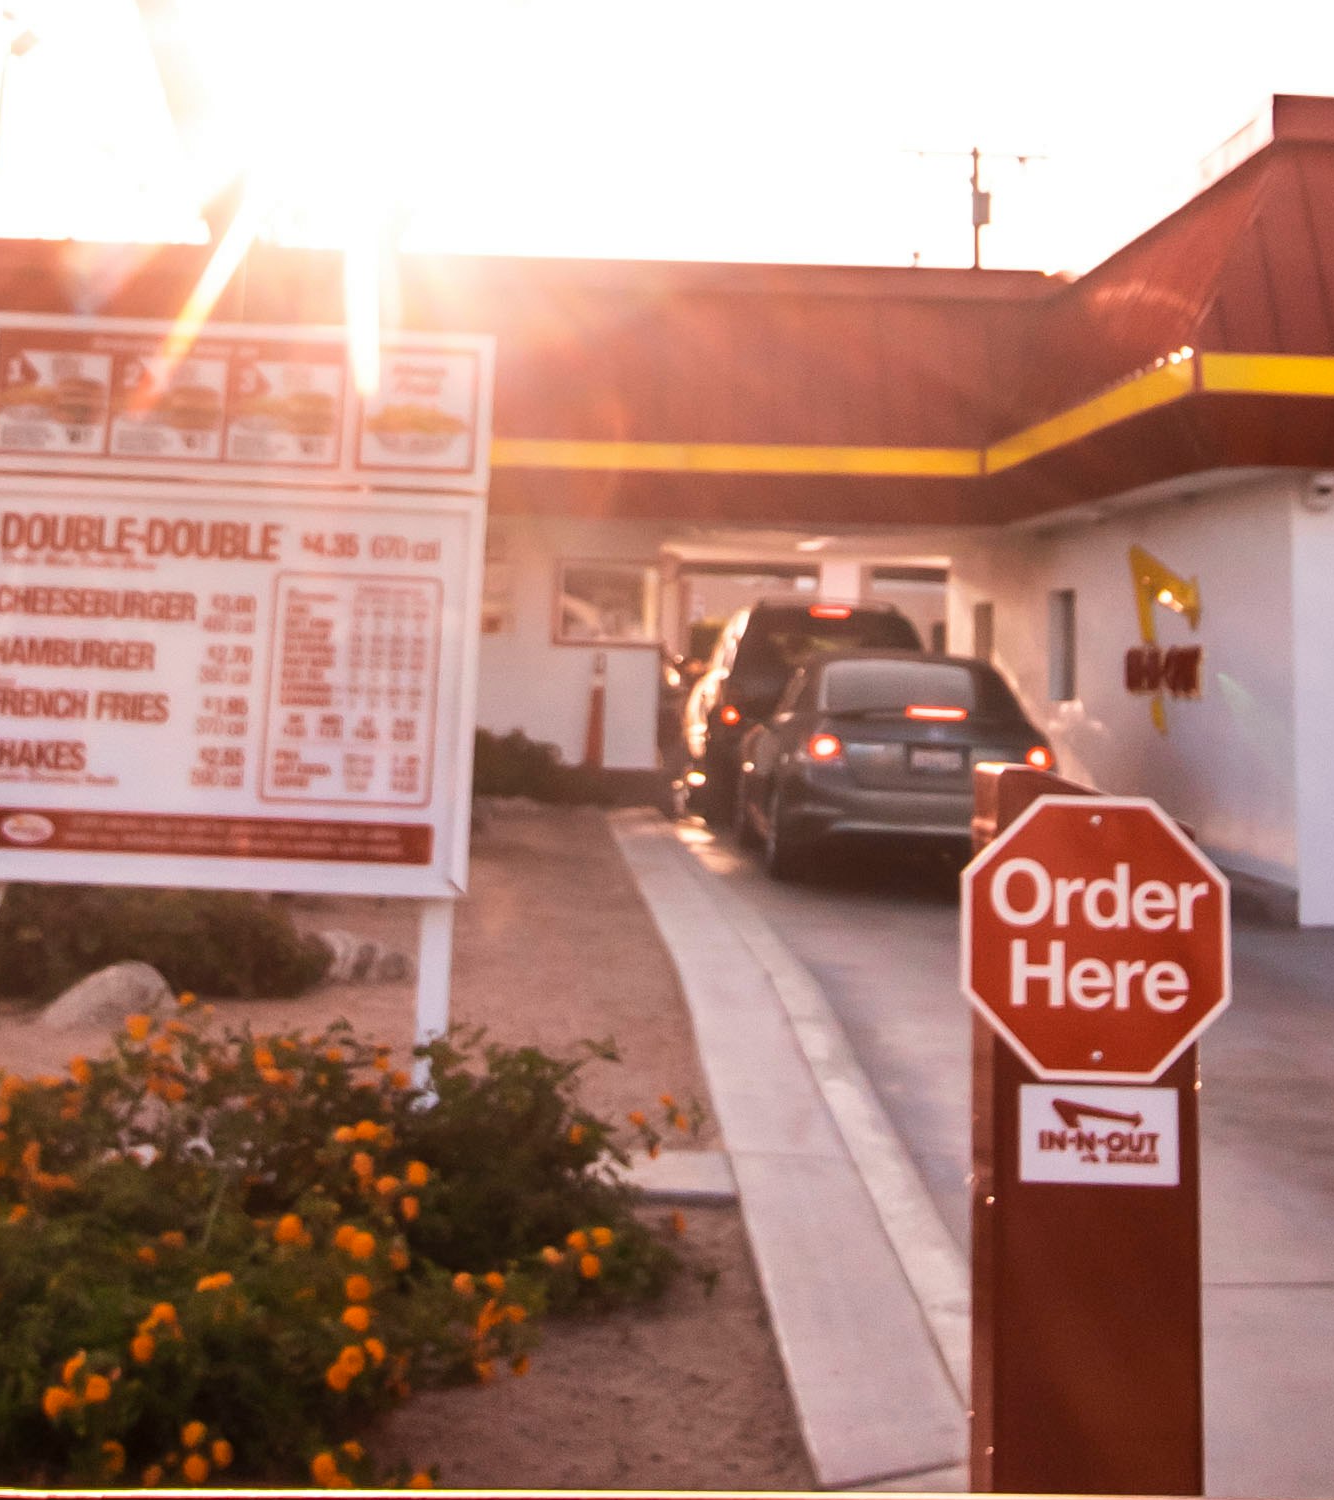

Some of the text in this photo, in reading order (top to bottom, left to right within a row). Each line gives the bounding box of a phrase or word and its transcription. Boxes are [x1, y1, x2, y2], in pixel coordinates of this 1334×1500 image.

[0, 512, 282, 562] DOUBLE-DOUBLE
[95, 690, 169, 724] FRIES
[991, 857, 1209, 932] Order
[1010, 938, 1190, 1014] Here
[1039, 1131, 1160, 1152] IN-N-OUT
